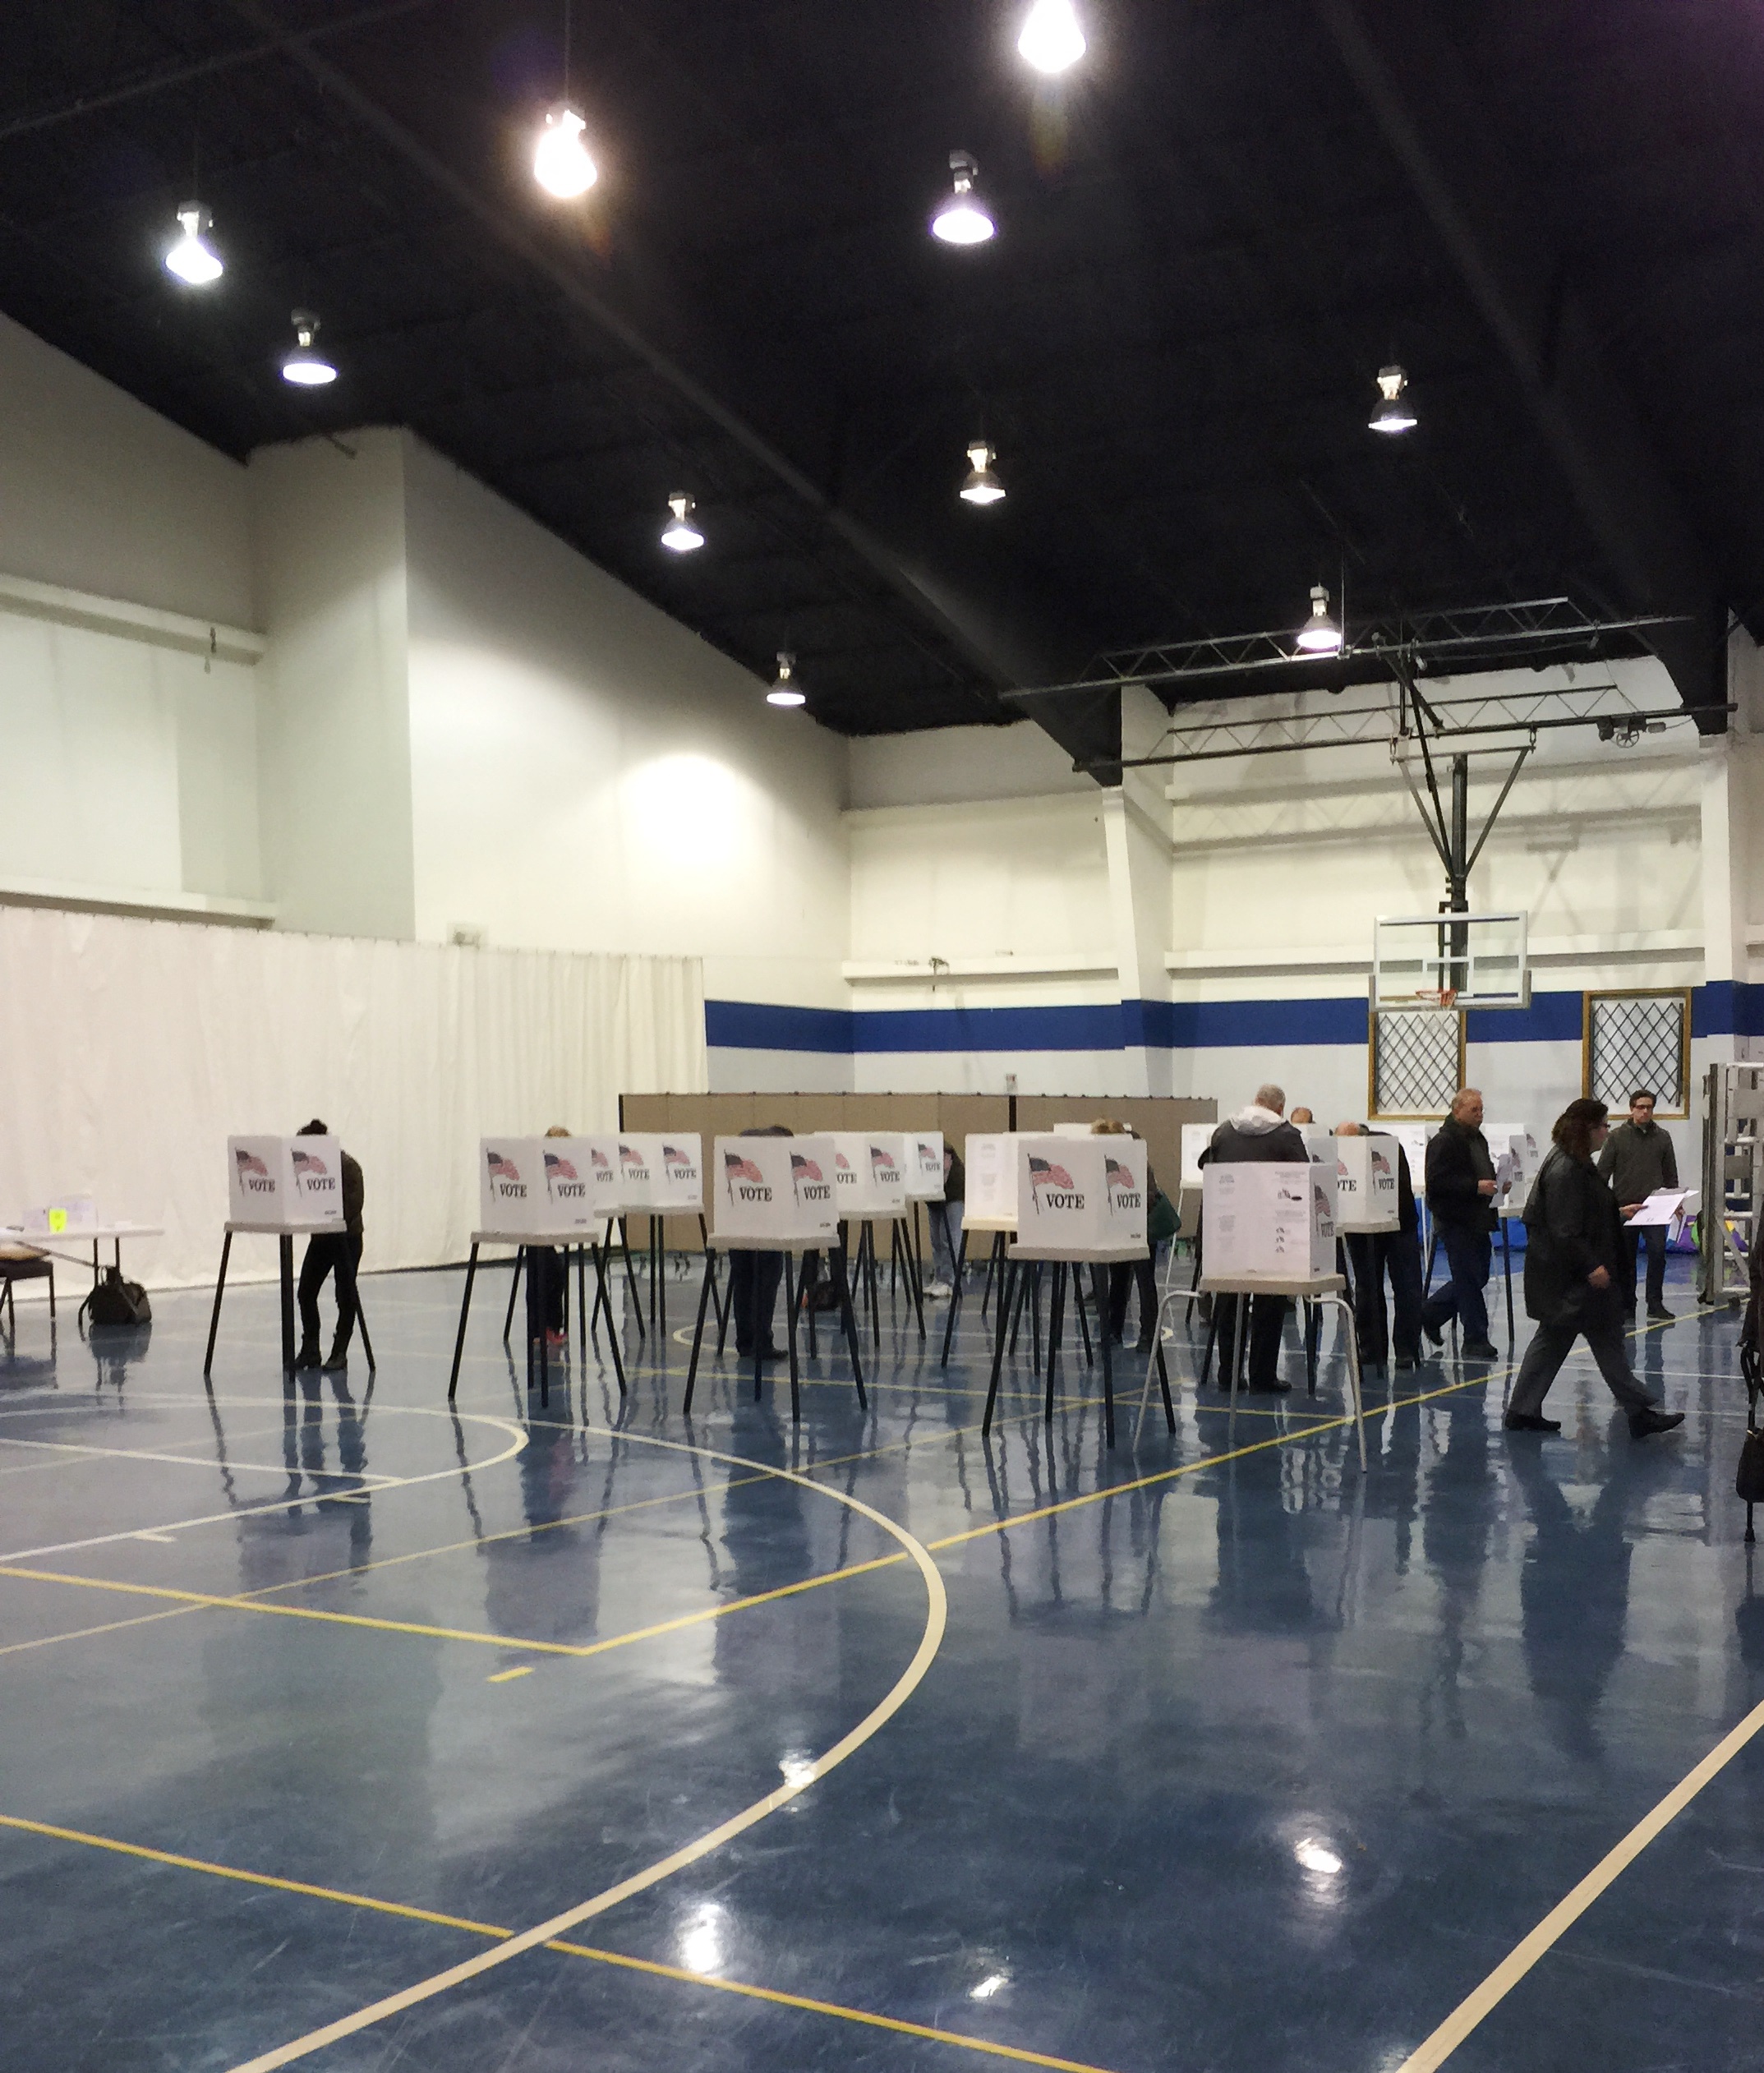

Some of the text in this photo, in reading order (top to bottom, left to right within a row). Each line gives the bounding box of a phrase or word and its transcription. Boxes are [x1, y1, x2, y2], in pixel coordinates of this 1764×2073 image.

[674, 1168, 697, 1179] VOTE
[925, 1162, 941, 1171] VOTE
[596, 1170, 614, 1182] VOTE
[629, 1168, 650, 1180] VOTE
[836, 1172, 857, 1184] OTE
[880, 1170, 900, 1182] VOTE
[248, 1177, 276, 1193] VOTE
[306, 1177, 336, 1191] VOTE
[500, 1182, 527, 1198] VOTE
[558, 1182, 586, 1198] VOTE
[1378, 1177, 1395, 1190] VOTE
[739, 1186, 773, 1202] VOTE
[804, 1184, 831, 1200] VOTE
[1046, 1193, 1085, 1209] VOTE
[1117, 1192, 1141, 1209] VOTE
